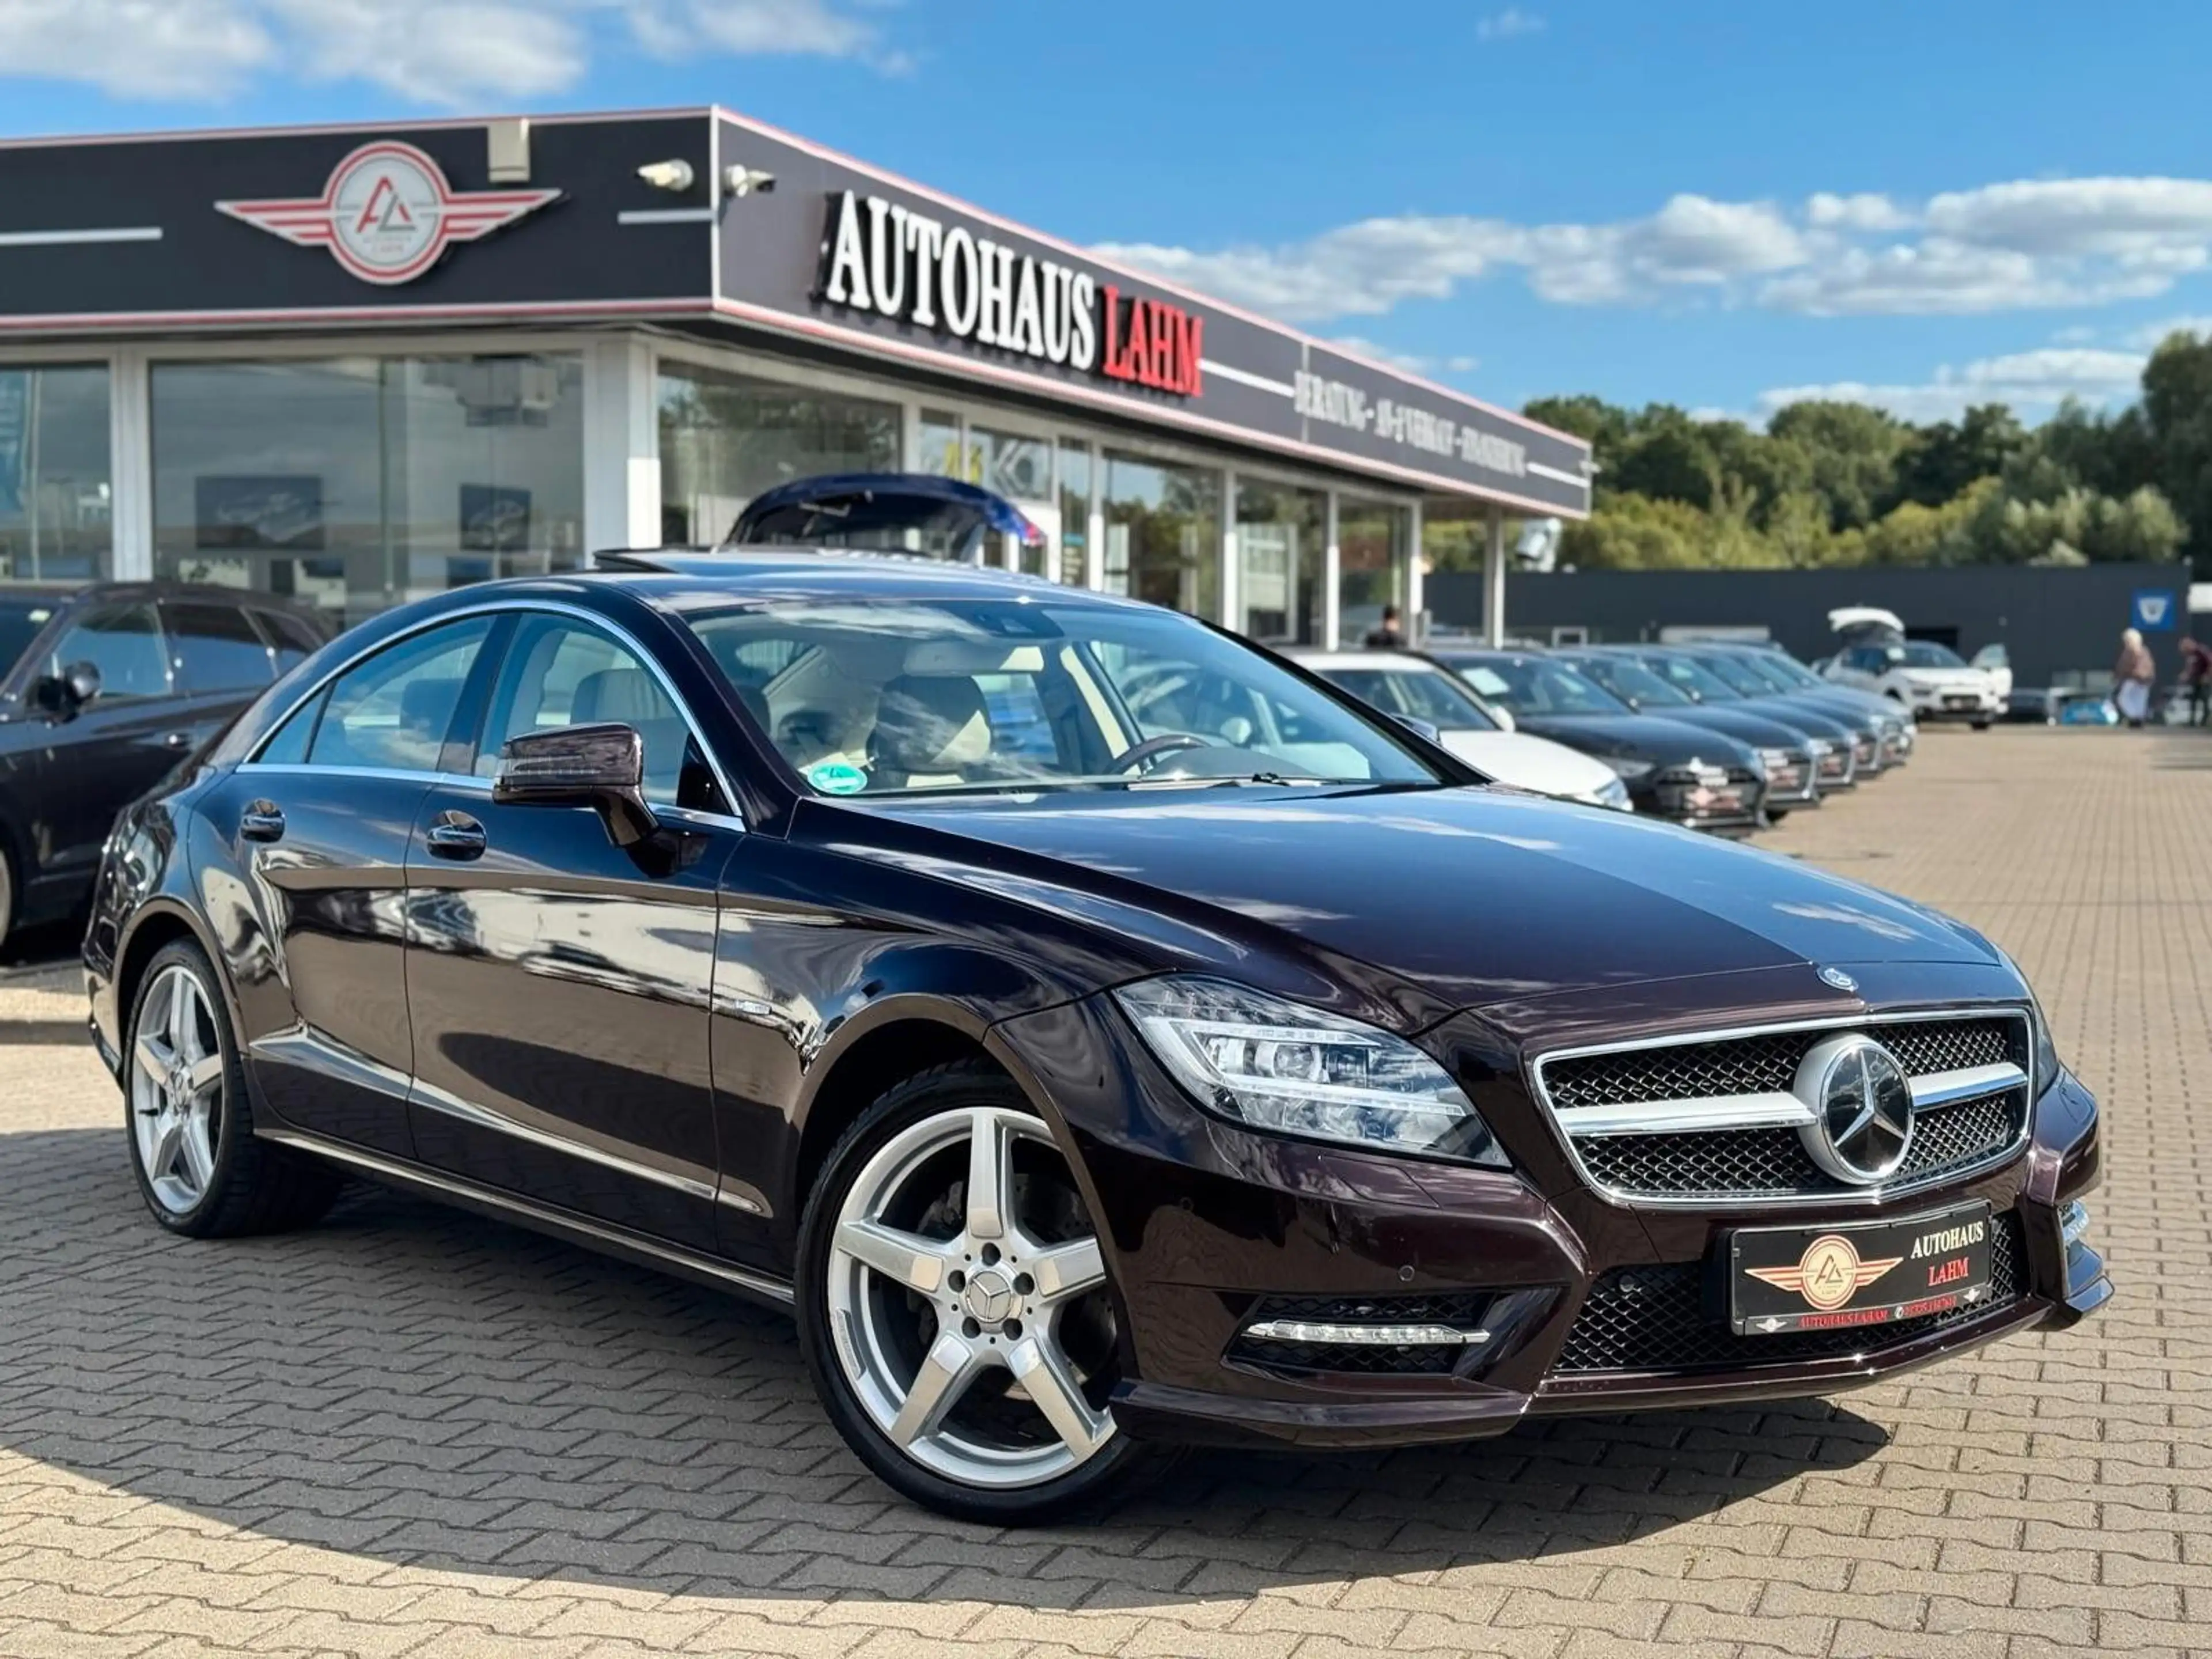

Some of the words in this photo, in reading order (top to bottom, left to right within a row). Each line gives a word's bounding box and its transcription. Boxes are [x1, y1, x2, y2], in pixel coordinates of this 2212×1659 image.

[827, 189, 1094, 370] AUTOHAUS
[1103, 284, 1203, 397] LAHM
[1910, 1221, 1983, 1259] AUTOHAUS
[1928, 1257, 1969, 1286] LAHM
